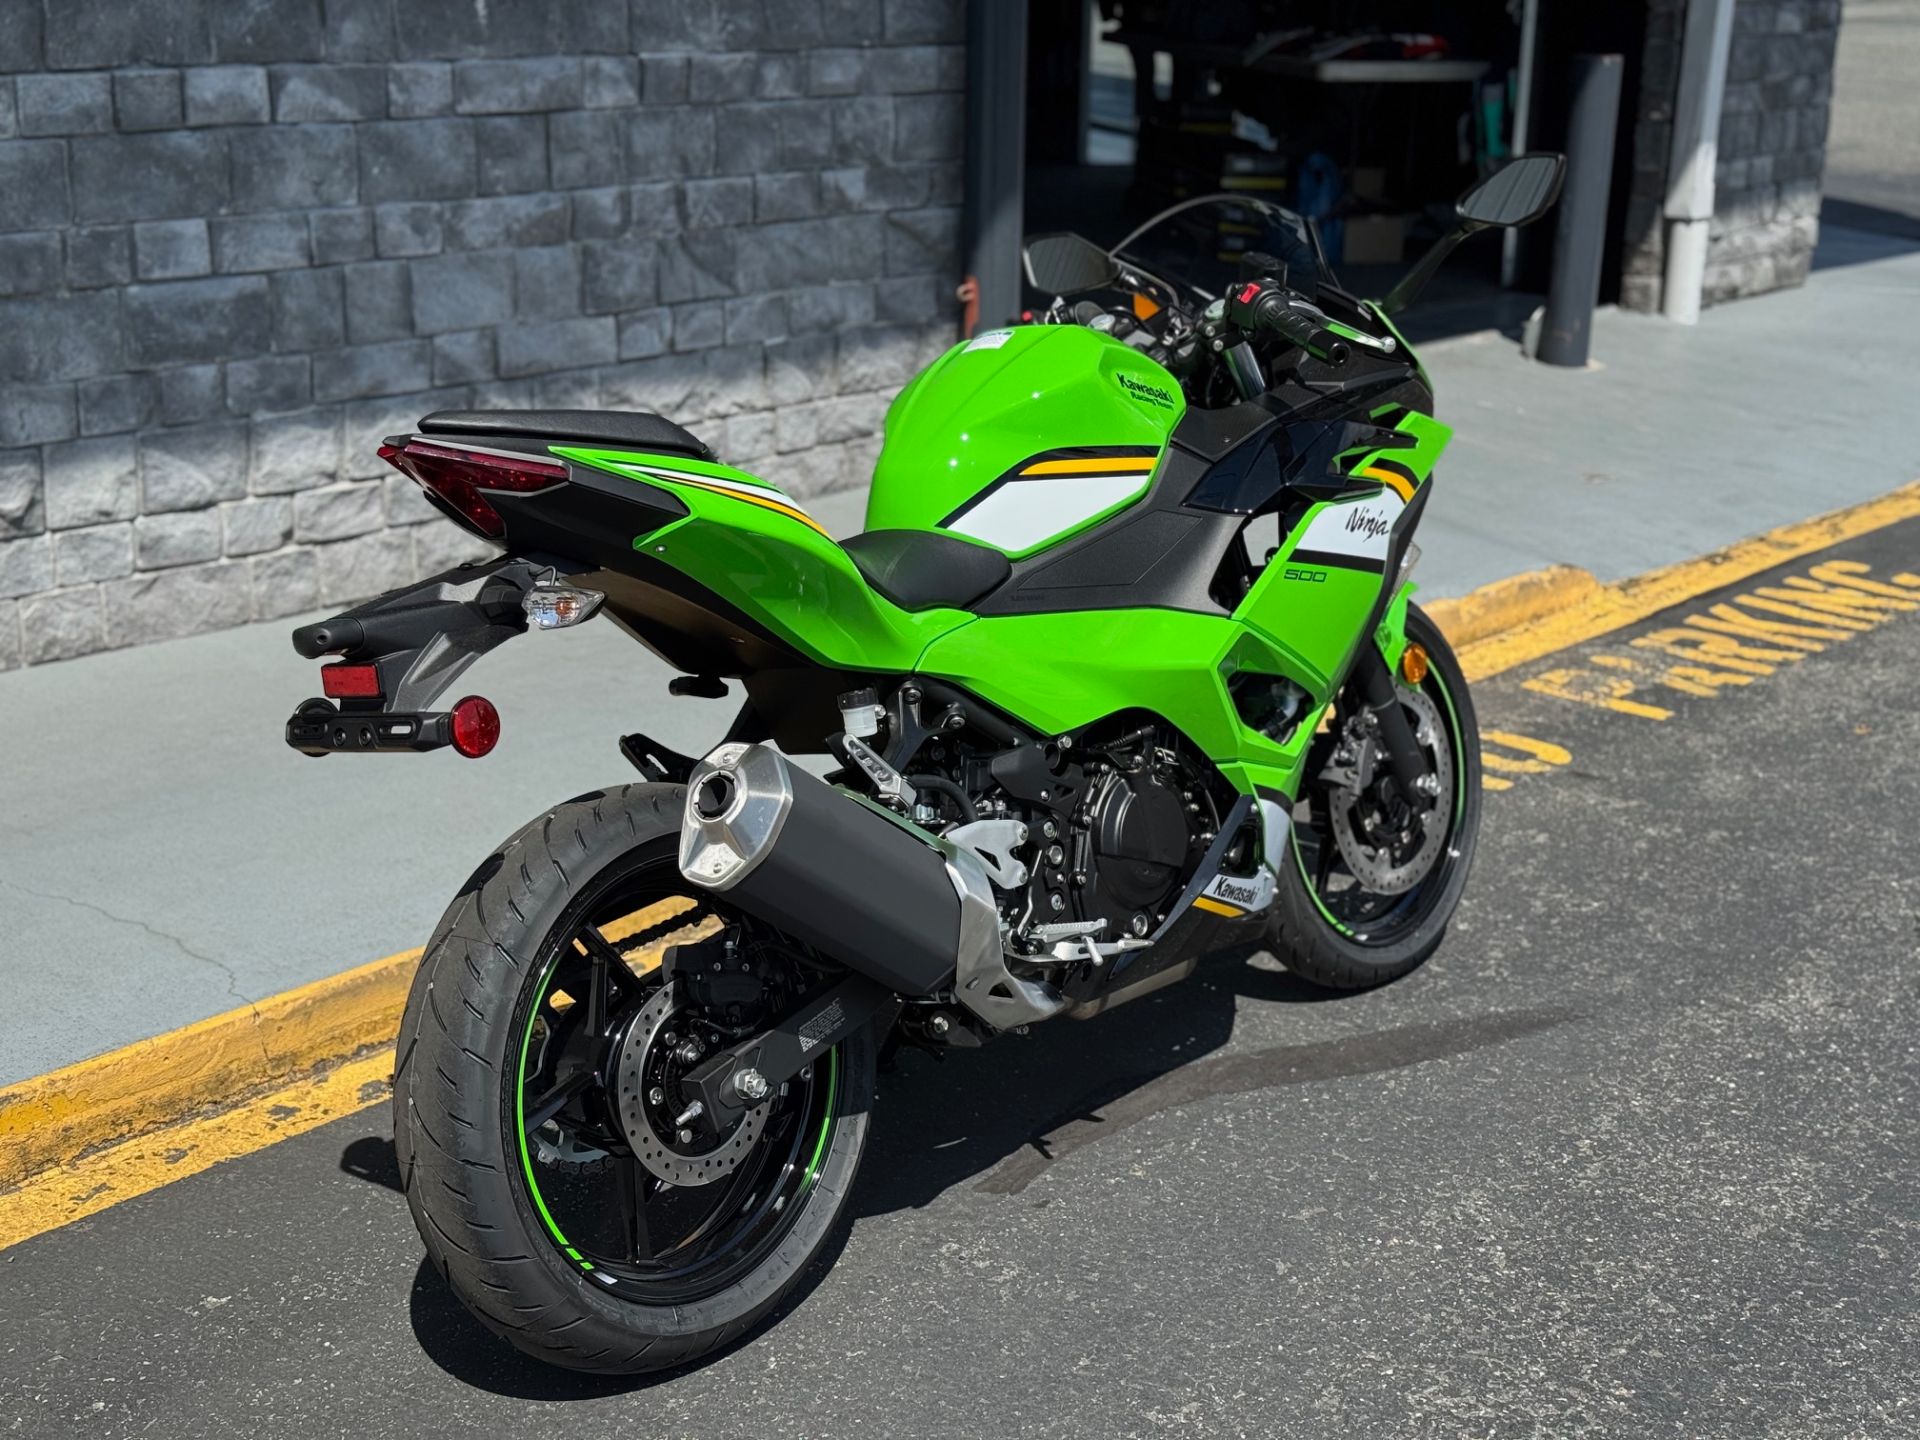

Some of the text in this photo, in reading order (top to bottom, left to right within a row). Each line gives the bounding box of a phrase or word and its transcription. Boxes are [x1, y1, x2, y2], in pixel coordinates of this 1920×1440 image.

[1116, 372, 1174, 404] Kawasaki
[1345, 506, 1389, 542] Ninja
[1284, 569, 1327, 582] 500
[1213, 876, 1260, 905] Kawasaki
